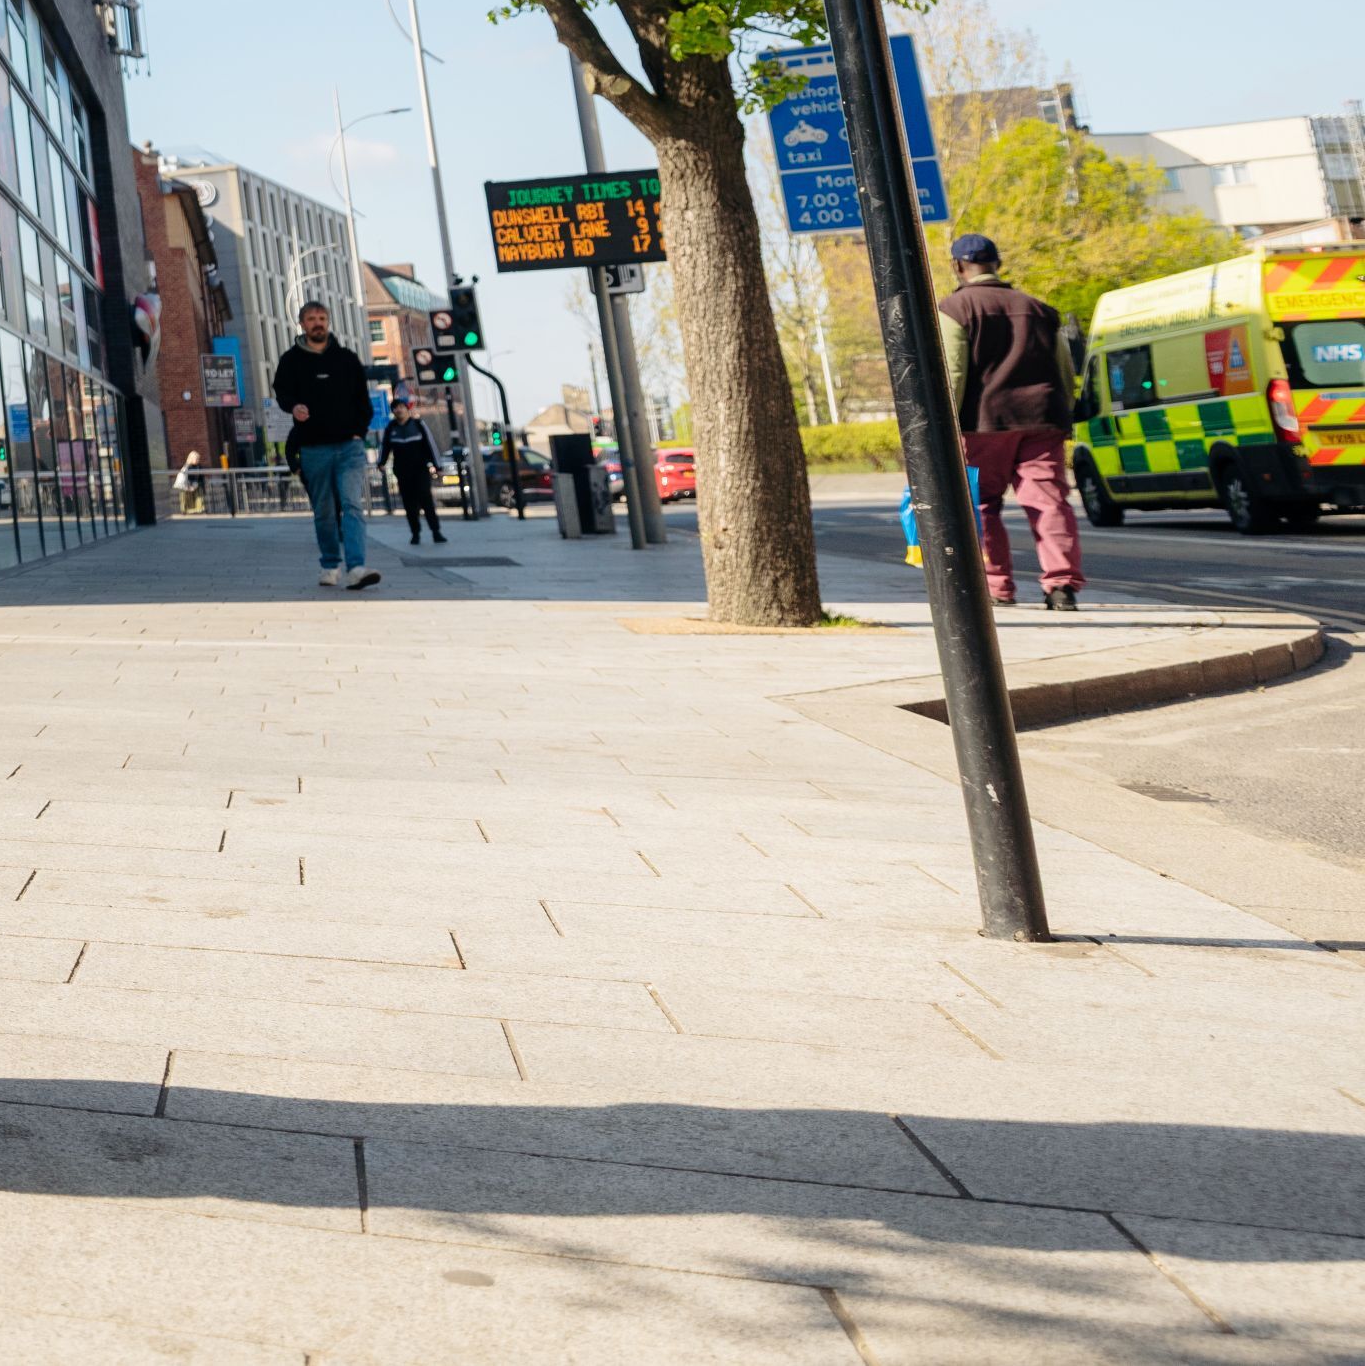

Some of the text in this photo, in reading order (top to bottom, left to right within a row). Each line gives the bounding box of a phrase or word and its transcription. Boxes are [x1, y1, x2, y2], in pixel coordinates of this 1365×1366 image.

[787, 148, 823, 164] taxi
[816, 175, 855, 188] Mon
[508, 186, 573, 207] JOURNEY
[581, 181, 632, 200] TIMES
[492, 198, 646, 227] DUNSWELL RBT 14
[494, 216, 650, 245] CALVERT LANE 9
[497, 234, 653, 263] MAYBURY RD 17
[1317, 344, 1363, 362] NHS
[205, 368, 235, 378] TO LET
